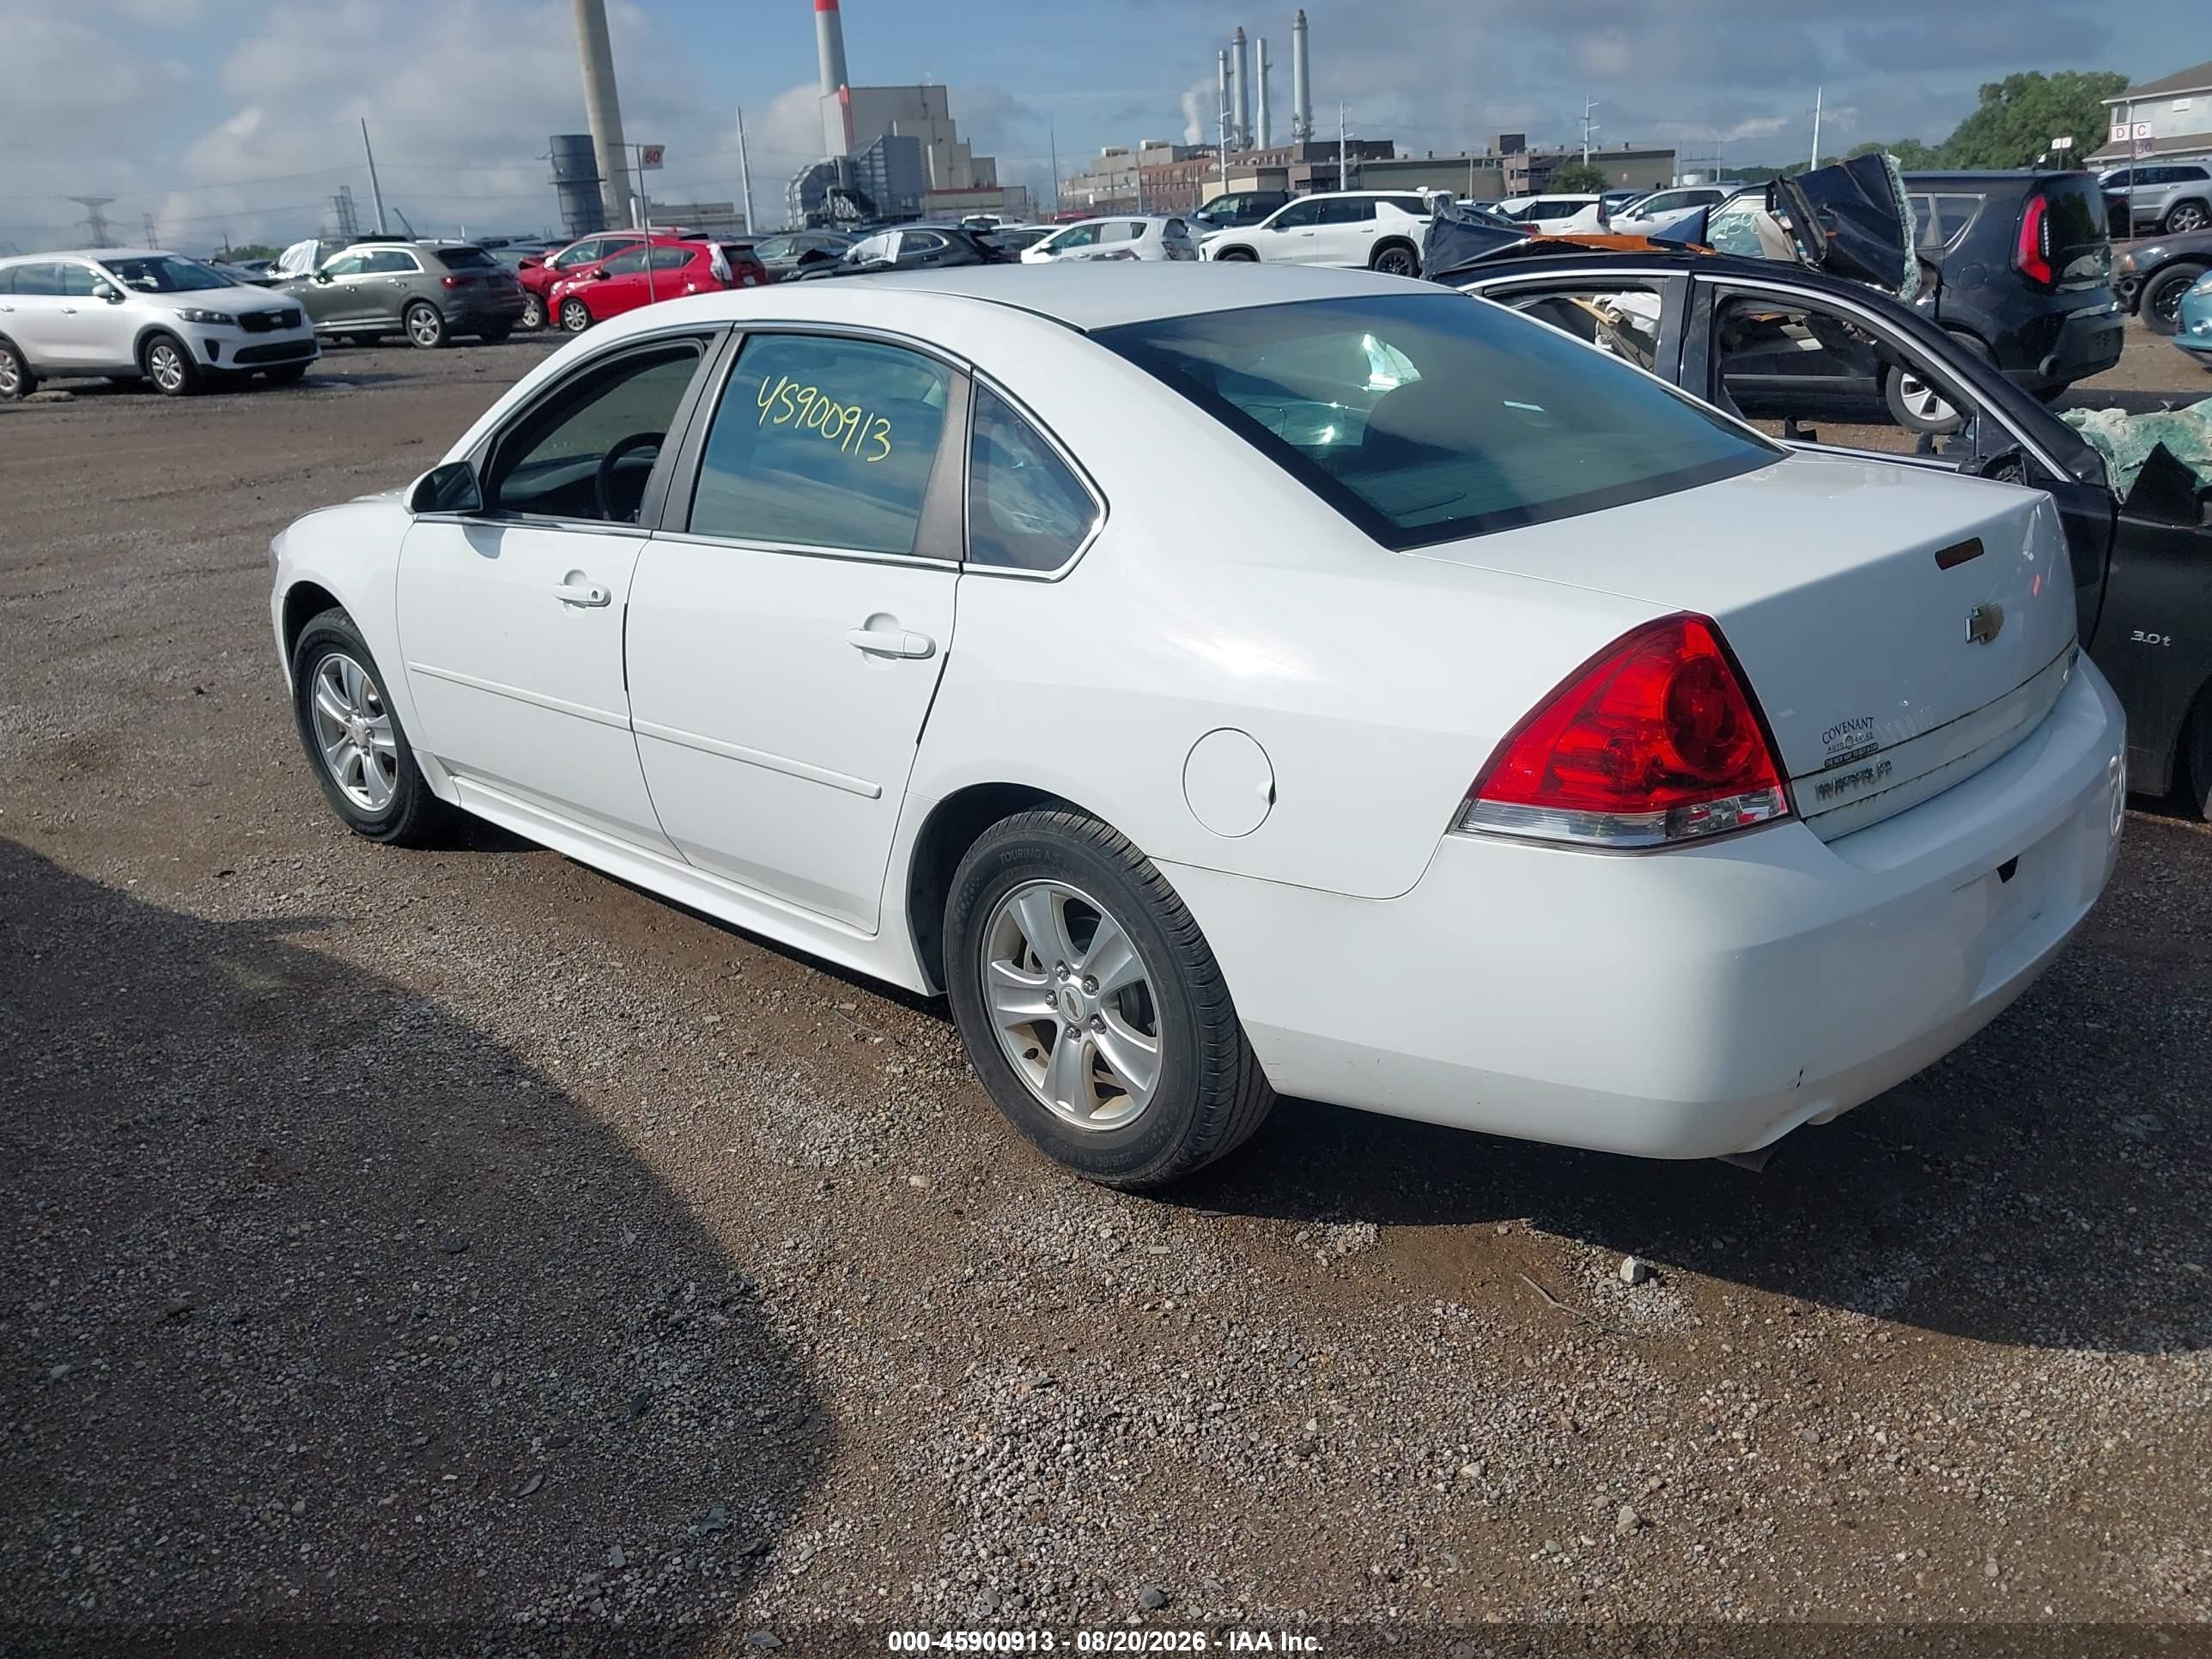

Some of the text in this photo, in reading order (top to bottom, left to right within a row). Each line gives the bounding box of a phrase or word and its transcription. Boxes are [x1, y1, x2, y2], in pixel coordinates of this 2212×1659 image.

[2116, 125, 2147, 139] D C
[757, 375, 891, 462] 45900913
[1821, 716, 1875, 744] COVENANT
[1827, 741, 1844, 752] AUTO
[999, 848, 1042, 865] TOURING
